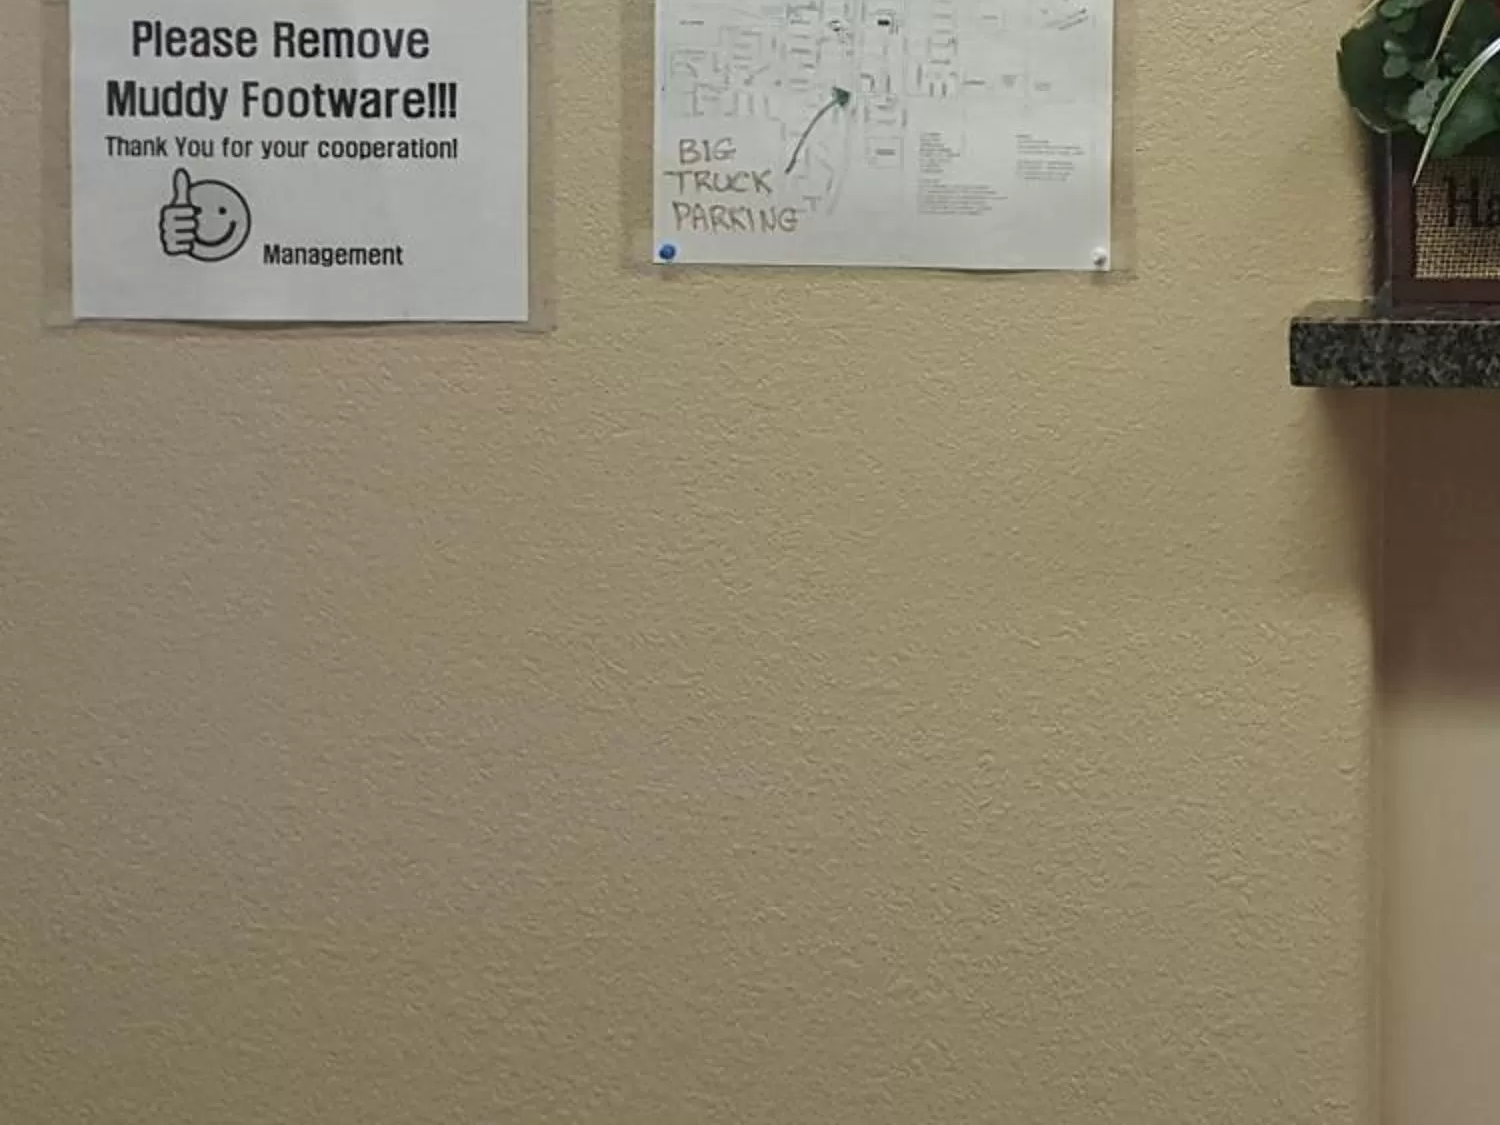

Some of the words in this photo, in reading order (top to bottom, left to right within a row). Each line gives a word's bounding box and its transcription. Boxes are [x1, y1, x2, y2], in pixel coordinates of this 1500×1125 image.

[131, 20, 258, 59] Please
[273, 21, 430, 60] Remove
[105, 80, 229, 121] Muddy
[241, 81, 458, 119] Footware!!!
[105, 135, 168, 158] Thank
[175, 135, 215, 158] You
[221, 136, 253, 158] for
[260, 139, 310, 160] your
[317, 137, 459, 161] cooperation!
[678, 136, 737, 165] BIG
[664, 168, 773, 195] TRUCK
[672, 201, 799, 234] PARKING
[262, 243, 405, 267] Management
